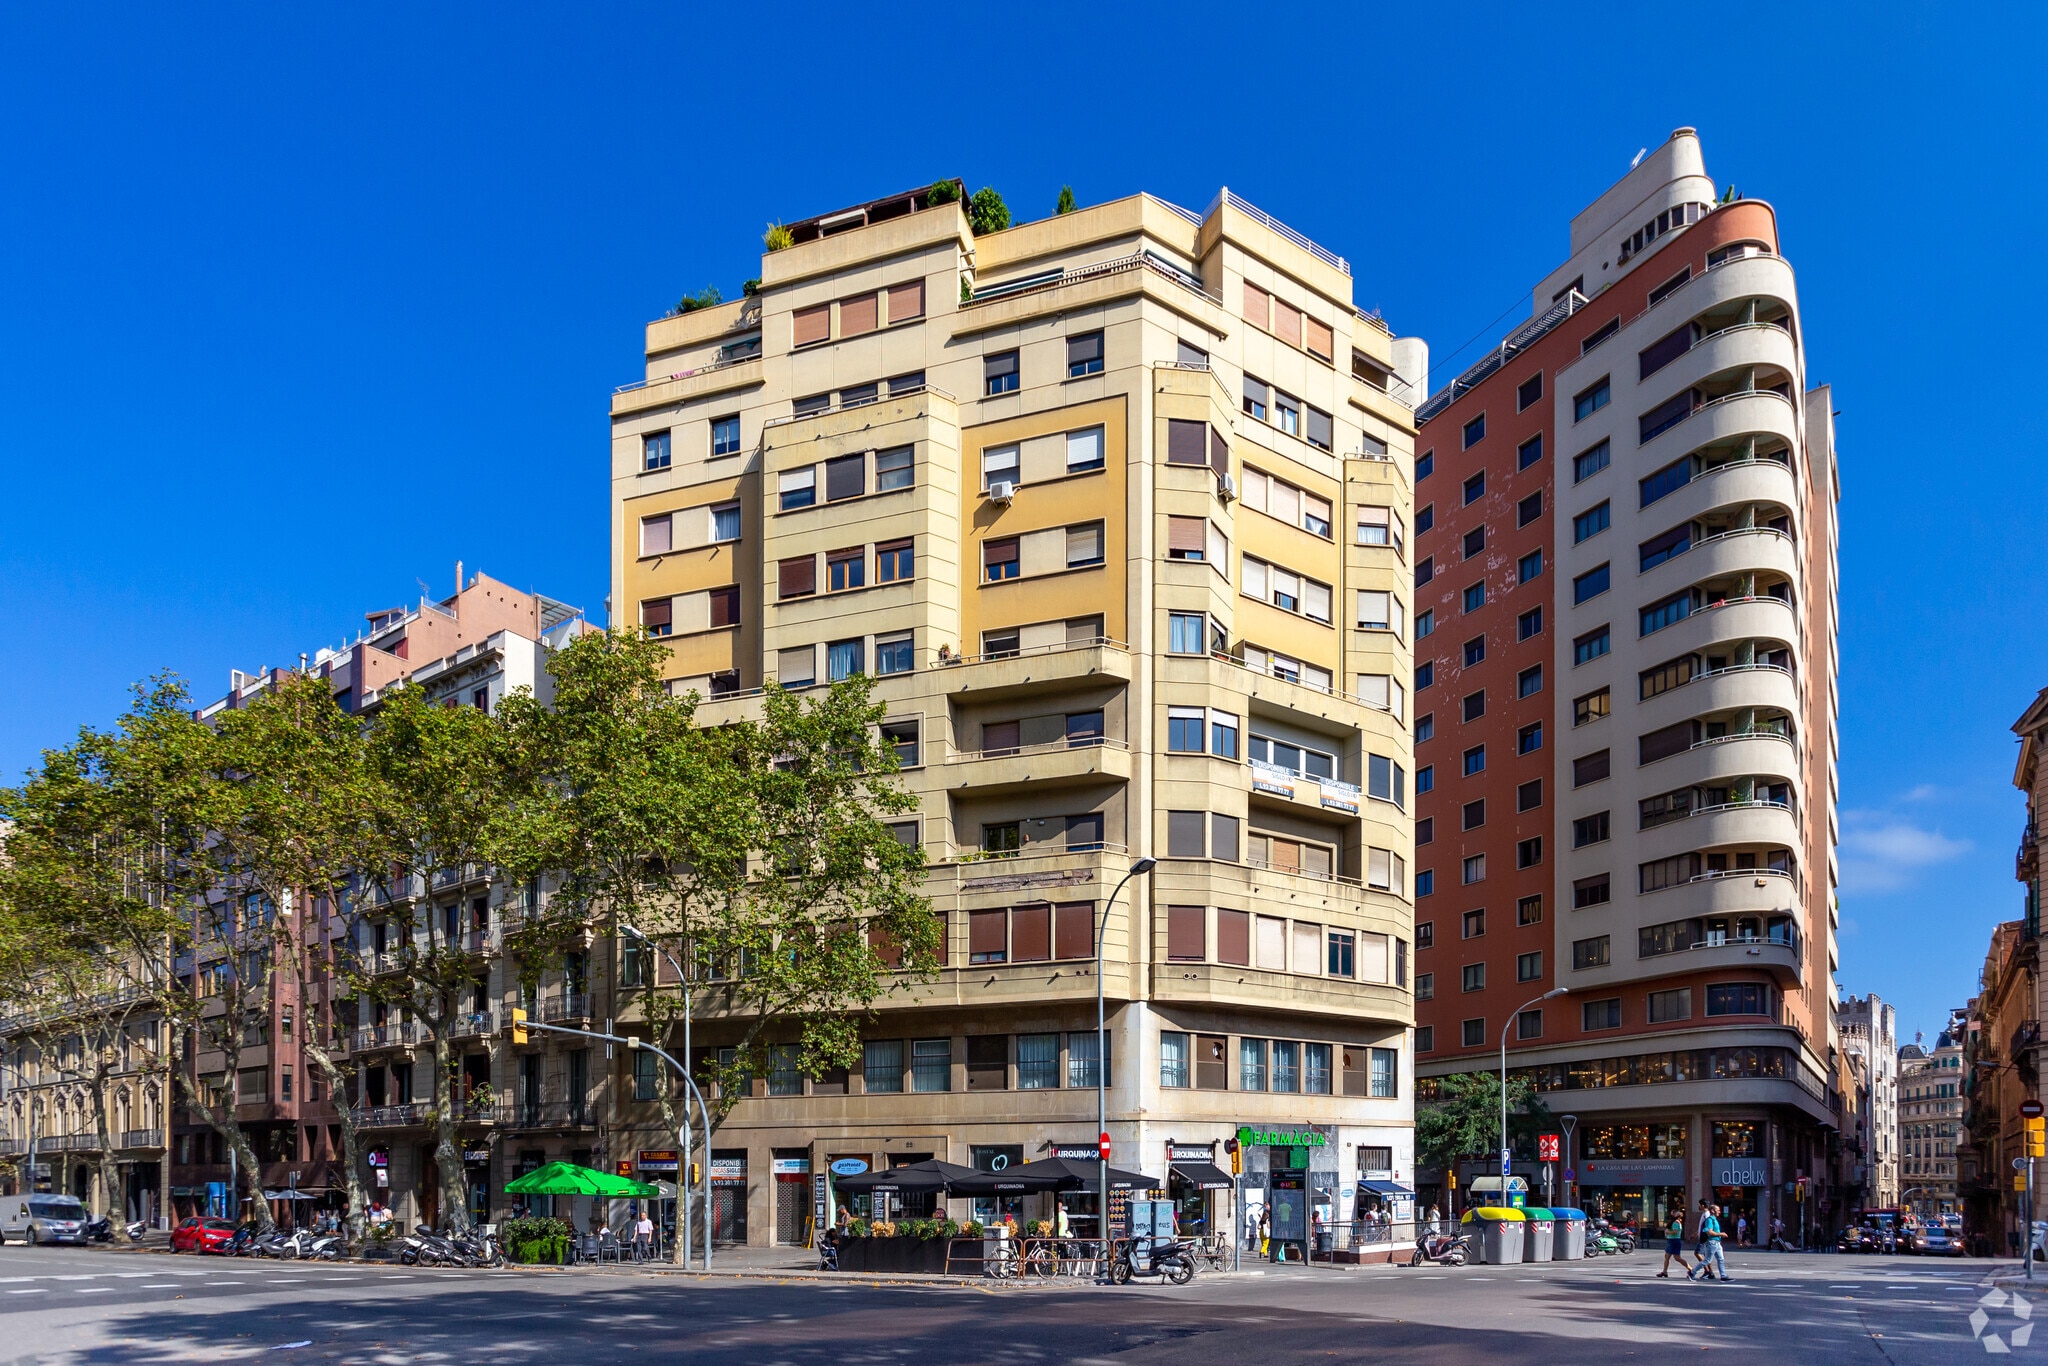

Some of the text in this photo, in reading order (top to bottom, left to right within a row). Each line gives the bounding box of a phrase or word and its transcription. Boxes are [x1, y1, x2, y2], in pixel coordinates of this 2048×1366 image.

[1258, 762, 1290, 776] DISPONIBLE
[1325, 780, 1355, 792] DISPONIBLE
[1253, 1128, 1325, 1147] FARMÀCIA
[1057, 1150, 1100, 1160] URQUINAON
[1172, 1151, 1213, 1159] URQUINAONA
[1503, 1151, 1509, 1165] P
[1721, 1159, 1765, 1185] abelux
